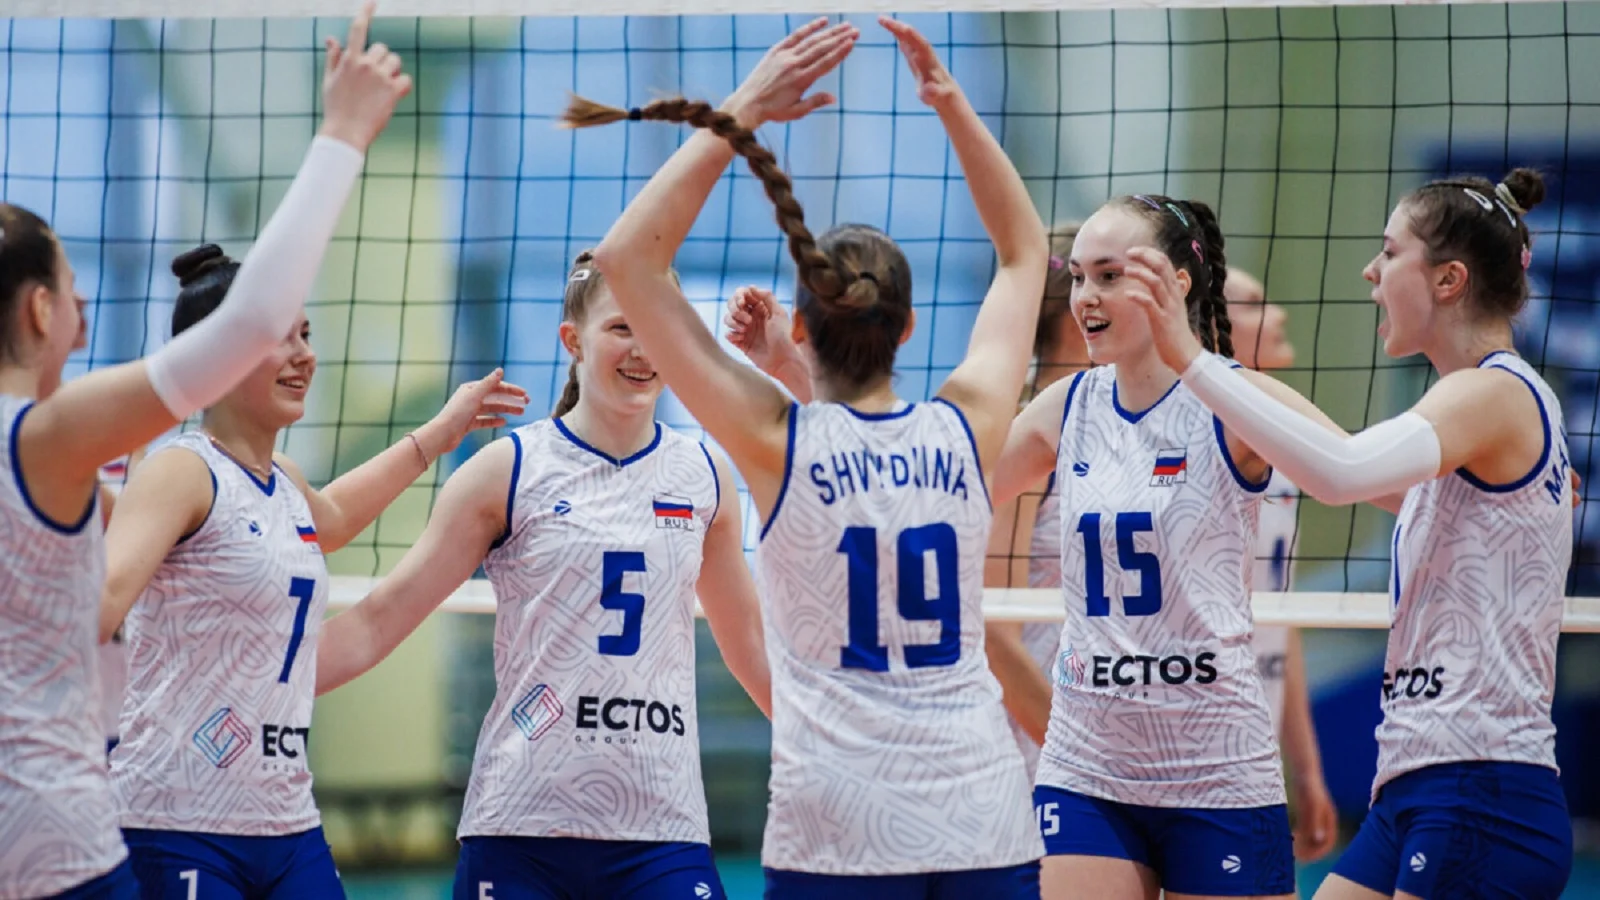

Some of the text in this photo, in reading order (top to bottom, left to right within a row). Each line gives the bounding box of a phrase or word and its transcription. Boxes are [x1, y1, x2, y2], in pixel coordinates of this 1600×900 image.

[664, 517, 689, 530] RUS
[1076, 511, 1162, 617] 15
[278, 576, 315, 683] 7
[597, 551, 647, 657] 5
[836, 522, 961, 673] 19
[576, 695, 685, 736] ECTOS
[1092, 652, 1217, 687] ECTOS
